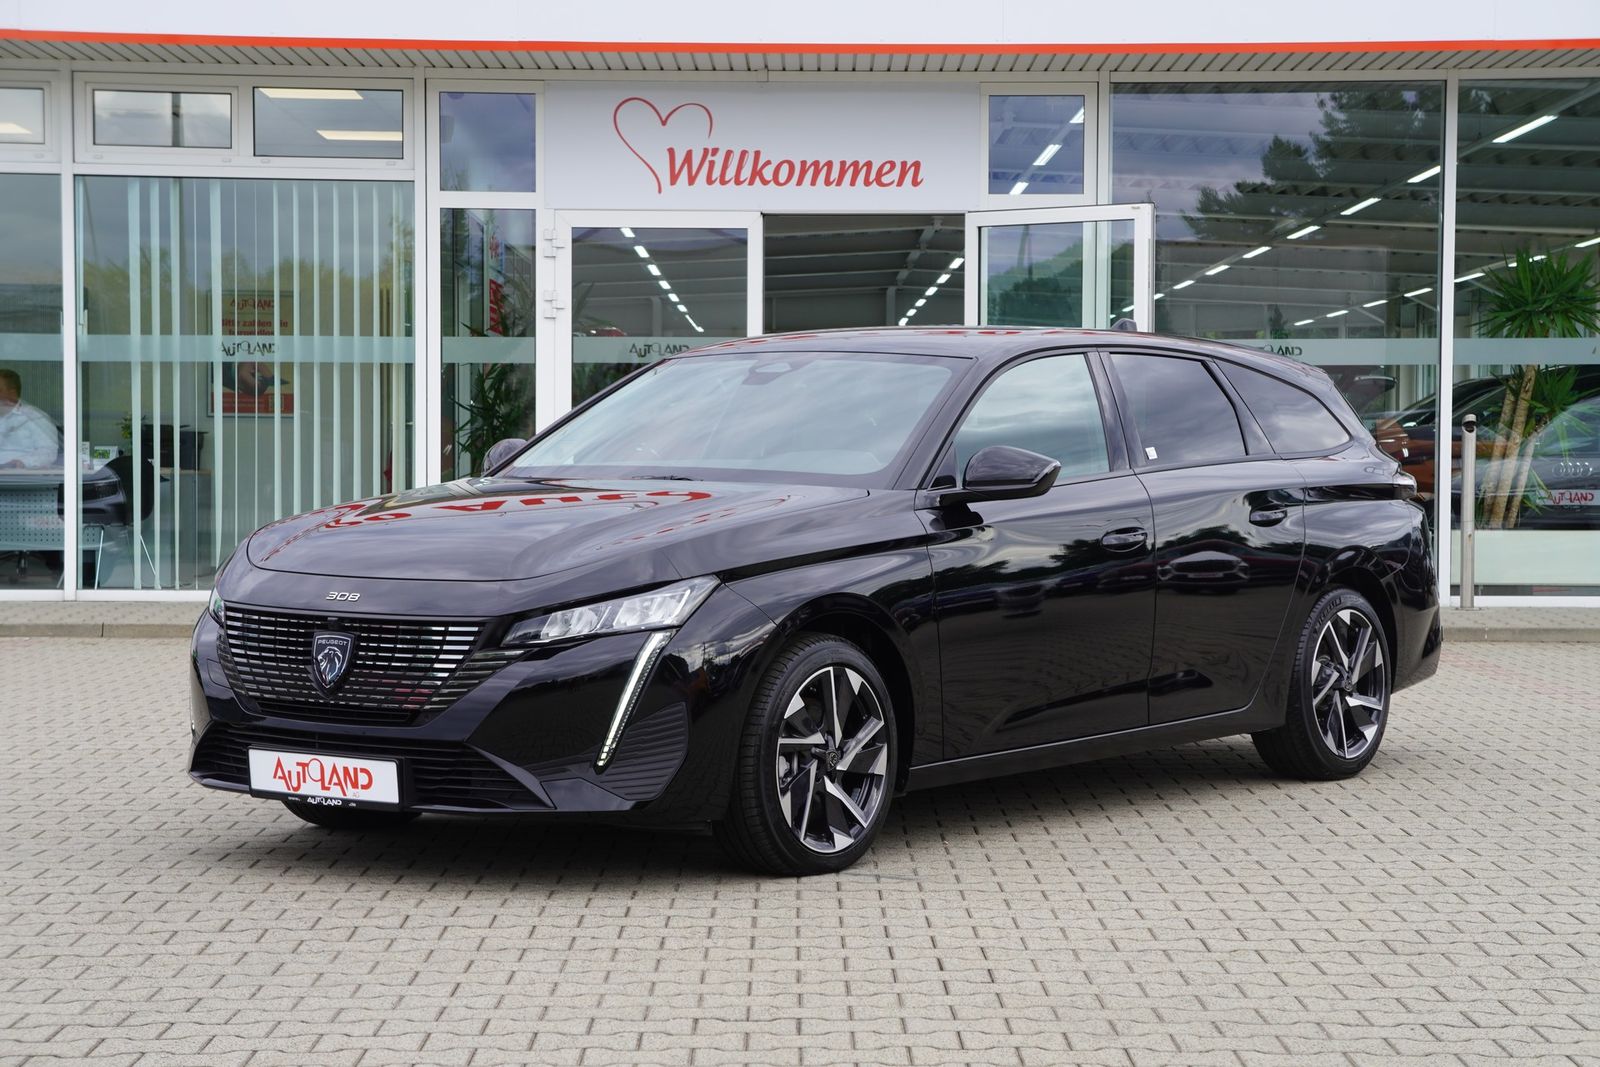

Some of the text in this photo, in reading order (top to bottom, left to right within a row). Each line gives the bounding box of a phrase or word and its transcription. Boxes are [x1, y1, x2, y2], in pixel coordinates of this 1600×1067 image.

[667, 147, 924, 187] Willkommen
[326, 591, 360, 601] 308
[273, 756, 373, 797] AUTOLAND
[307, 796, 343, 806] AUTOLAND
